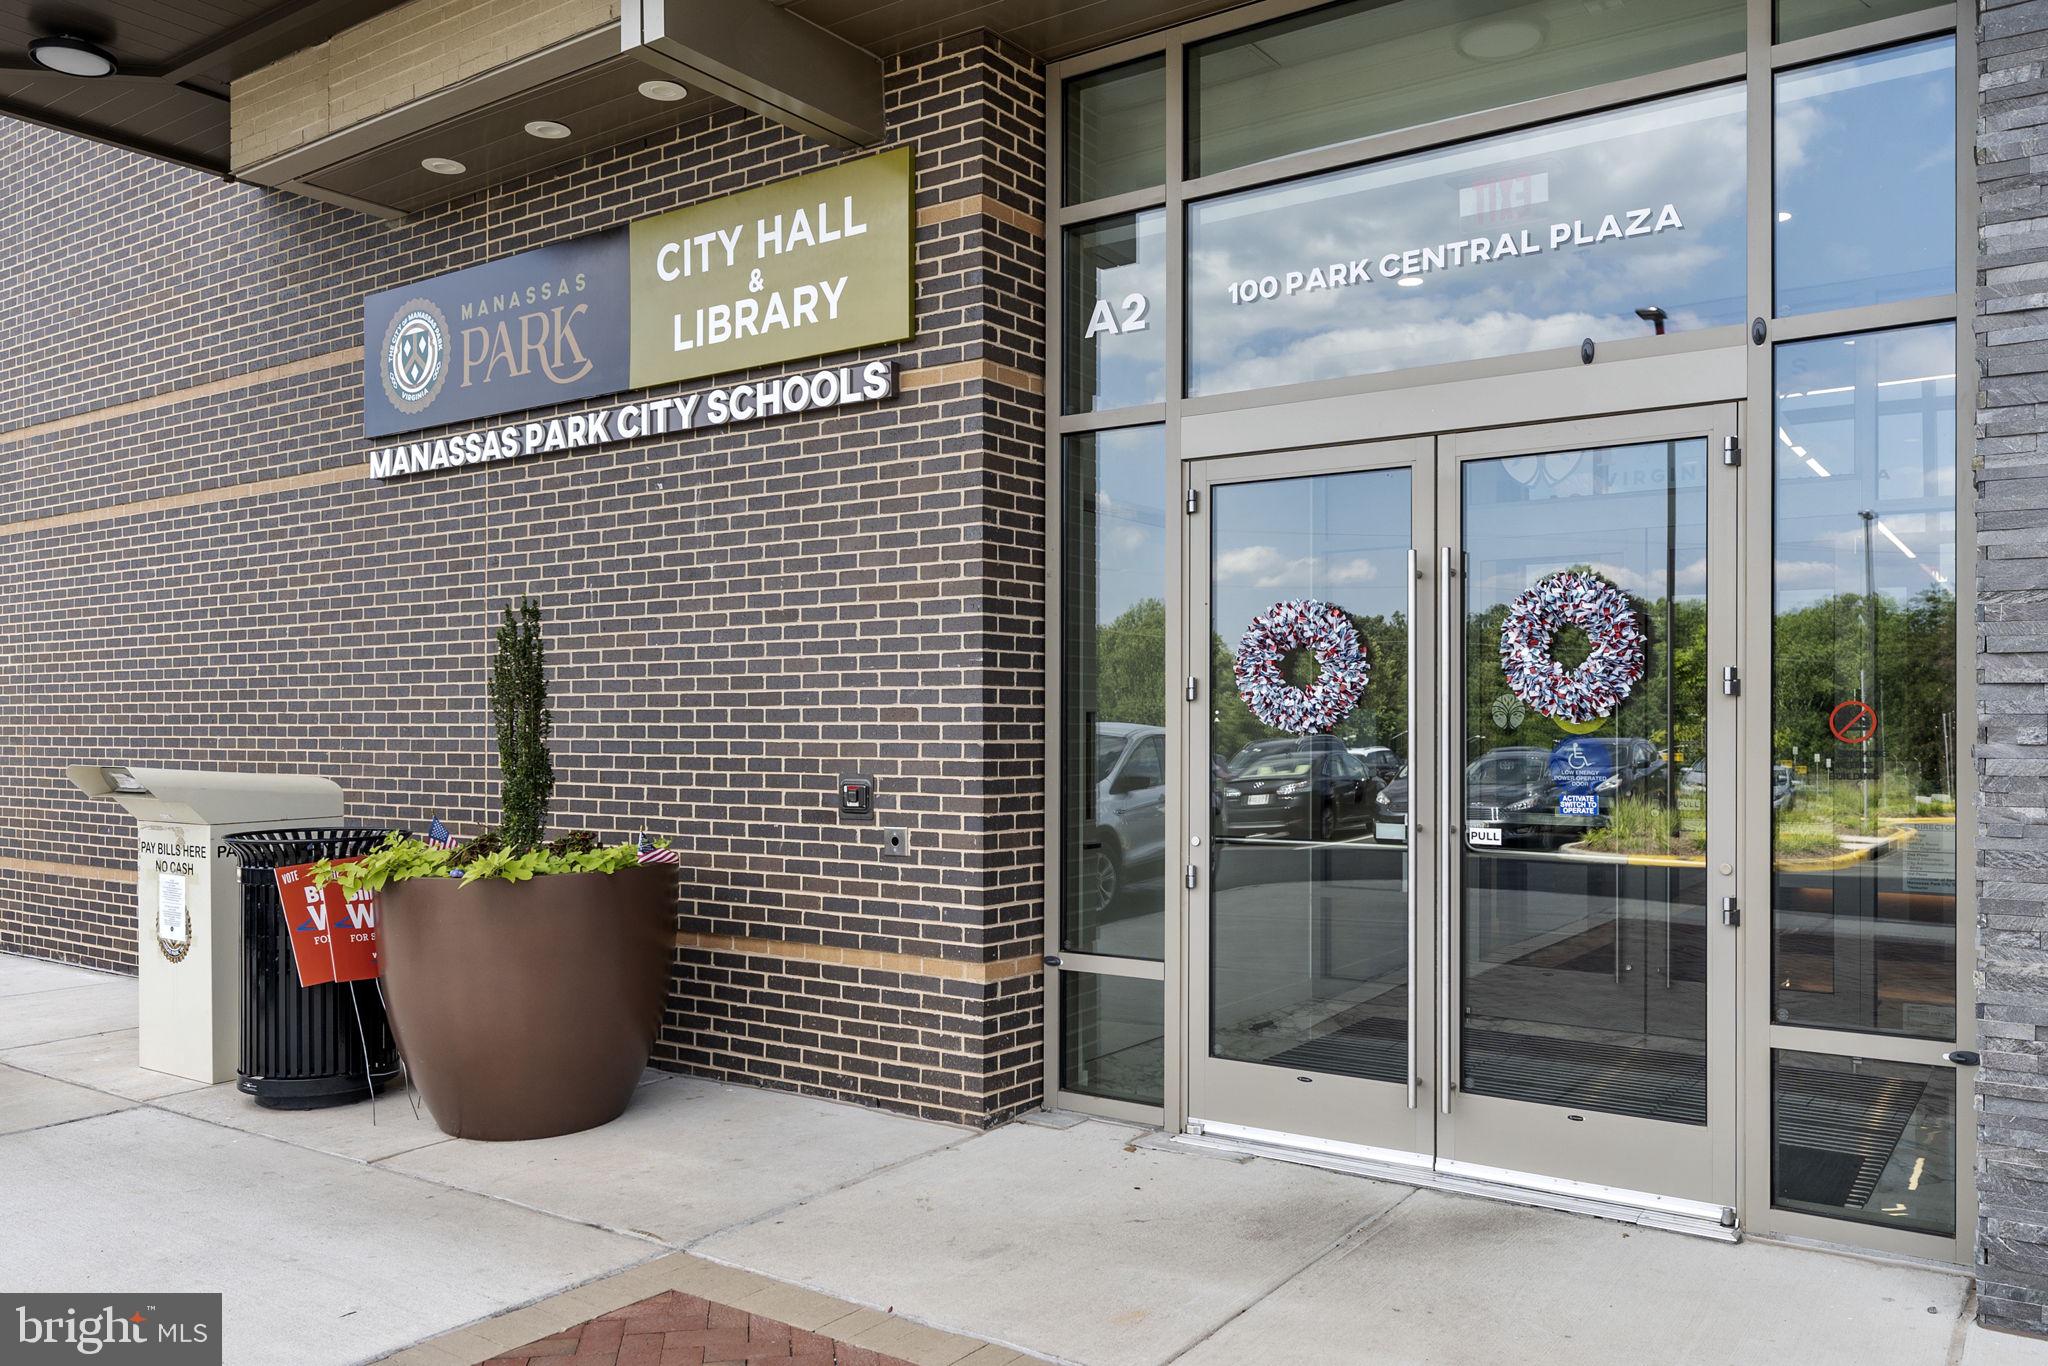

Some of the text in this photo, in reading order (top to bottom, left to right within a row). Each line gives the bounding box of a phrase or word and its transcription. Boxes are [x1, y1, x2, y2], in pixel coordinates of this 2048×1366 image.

[656, 196, 867, 282] CITY HALL
[1228, 203, 1683, 304] 100 PARK CENTRAL PLAZA
[749, 268, 764, 293] &
[461, 273, 586, 320] MANASSAS
[407, 311, 436, 329] MANASSAS
[674, 276, 848, 352] LIBRARY
[1084, 293, 1147, 339] A2
[391, 323, 402, 344] CITY
[435, 328, 443, 350] PARK
[388, 344, 396, 362] THE
[460, 303, 593, 387] PARK
[401, 389, 428, 401] VIRGINIA
[370, 361, 889, 479] MANASSAS PARK CITY SCHOOLS
[1471, 831, 1500, 841] PULL
[141, 841, 206, 858] PAY BILLS HERE
[217, 845, 237, 858] PA
[155, 860, 194, 875] NO CASH
[281, 870, 300, 885] VOTE
[350, 933, 369, 942] FOR
